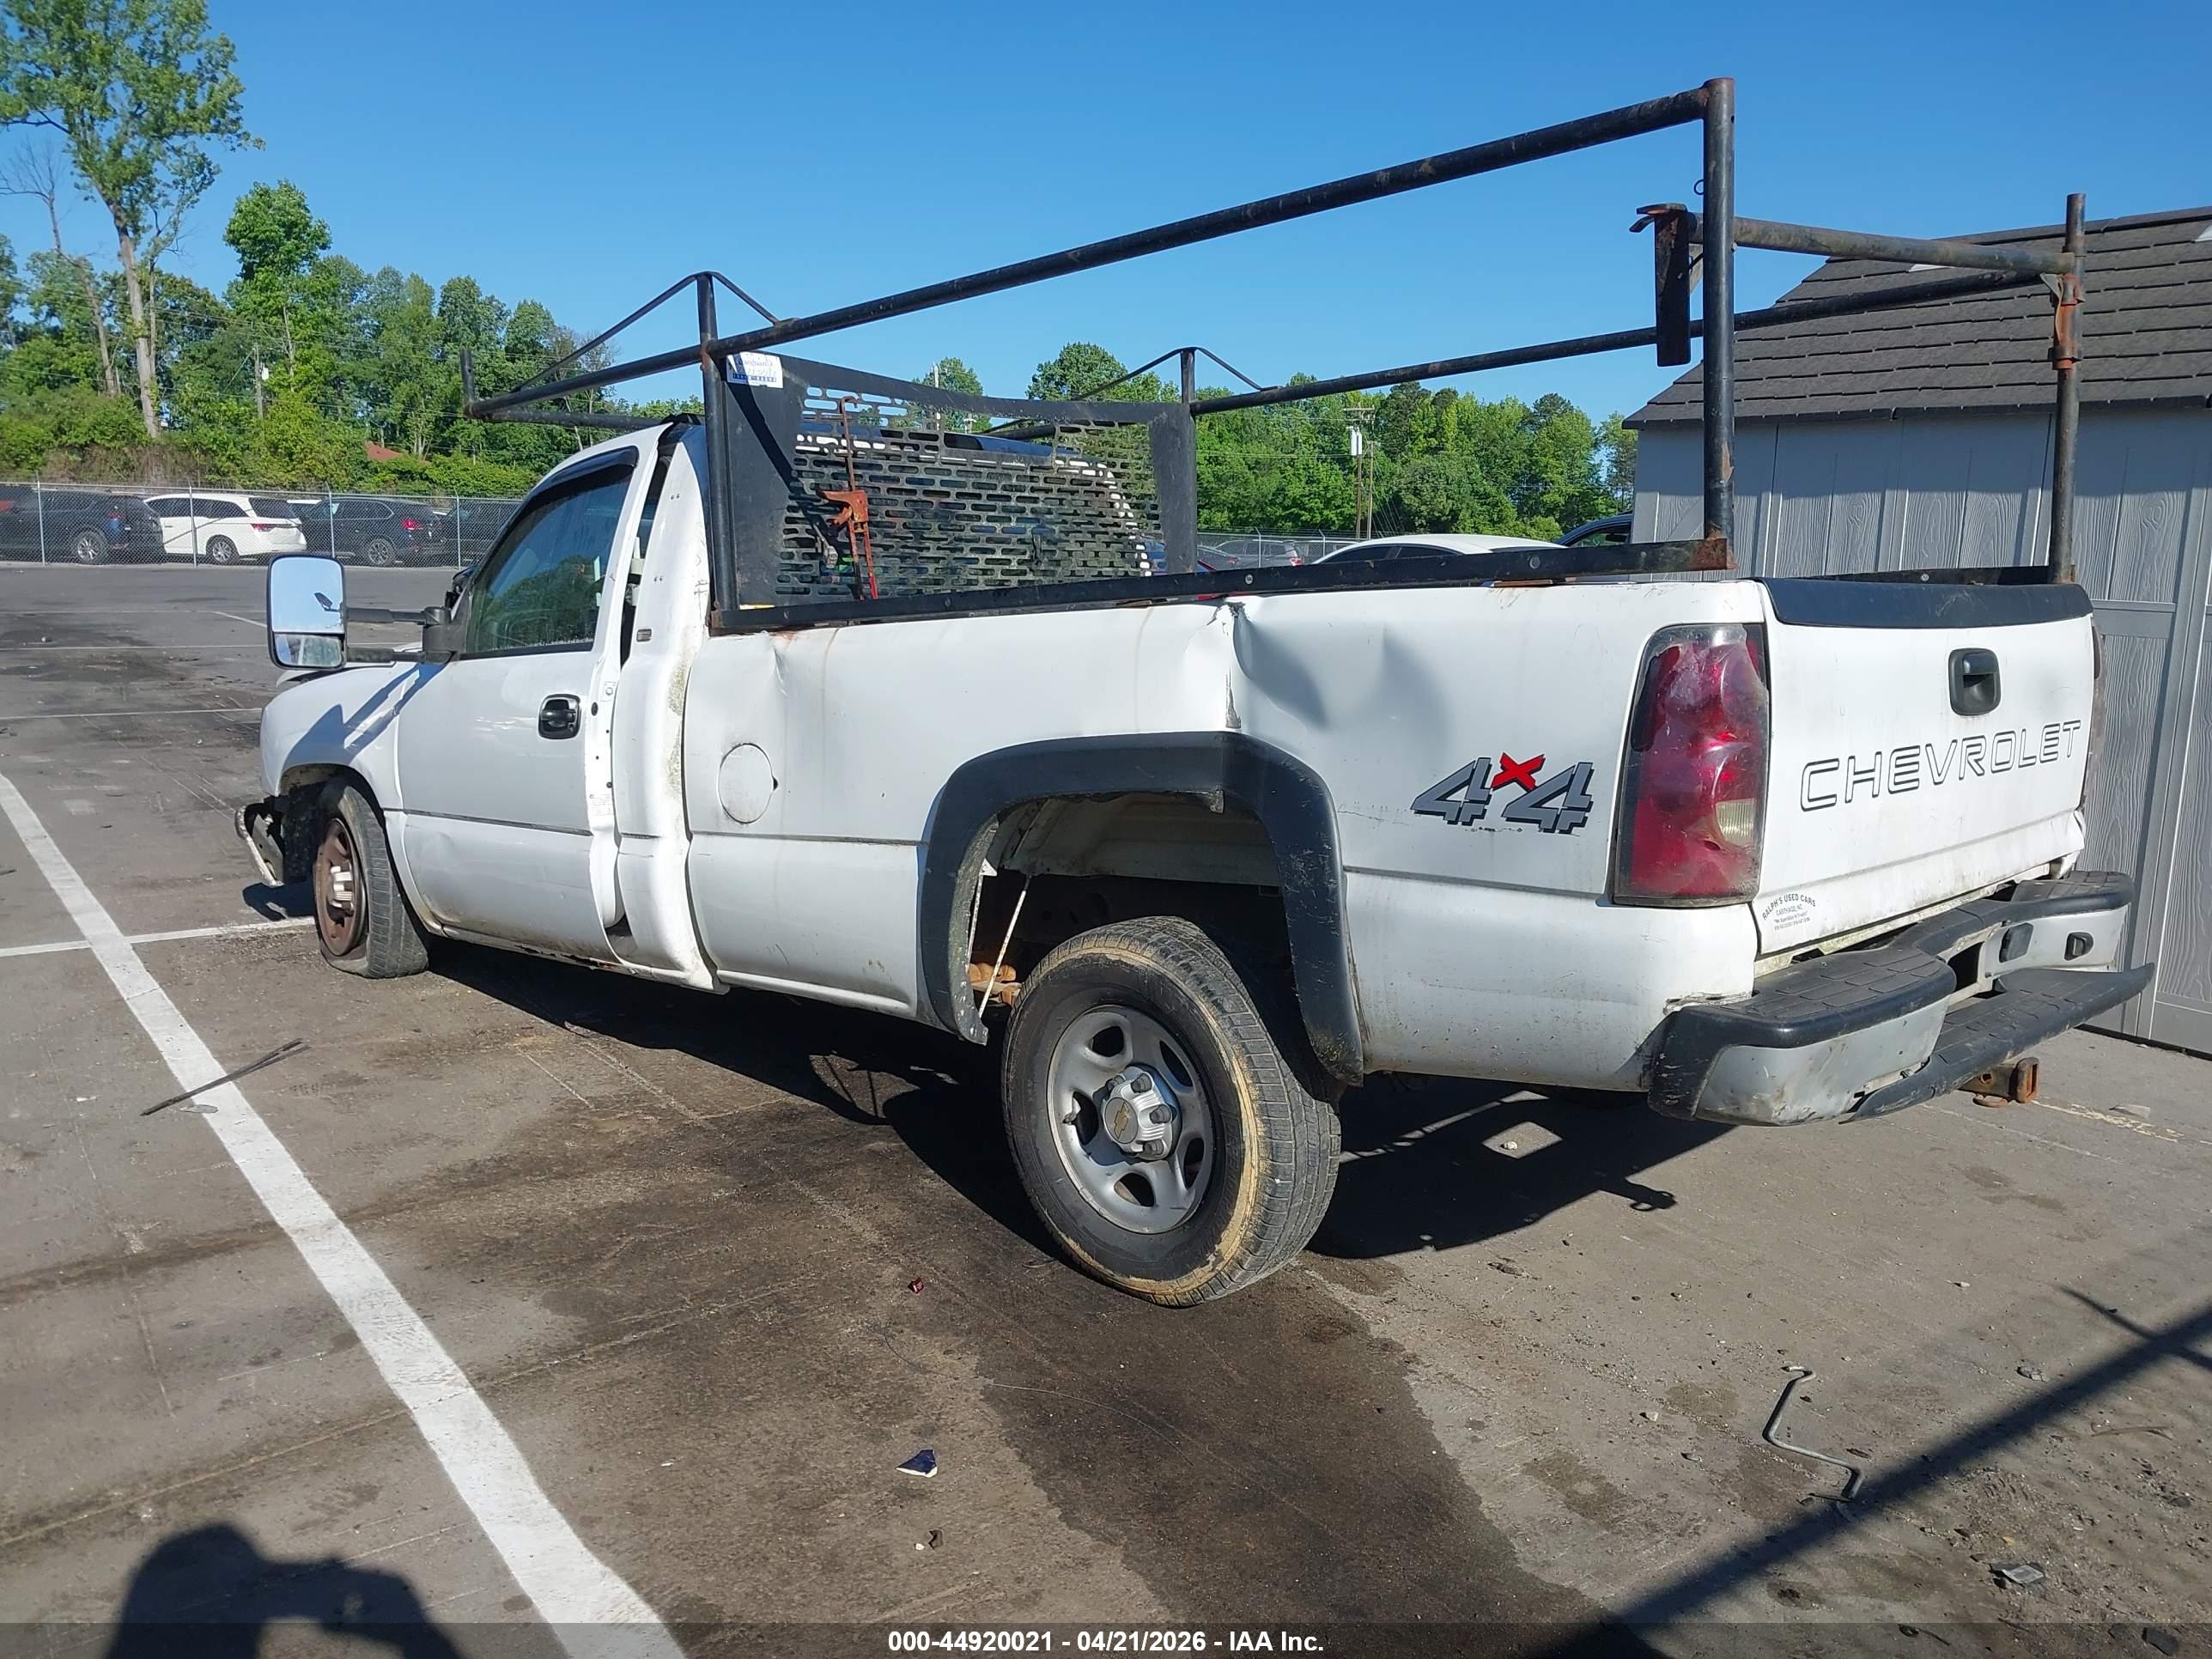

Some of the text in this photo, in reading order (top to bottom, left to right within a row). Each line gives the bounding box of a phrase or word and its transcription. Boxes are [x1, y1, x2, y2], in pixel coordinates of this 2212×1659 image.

[1800, 719, 2081, 812] CHEVROLET
[1762, 893, 1816, 921] RALPH'S USED CARS
